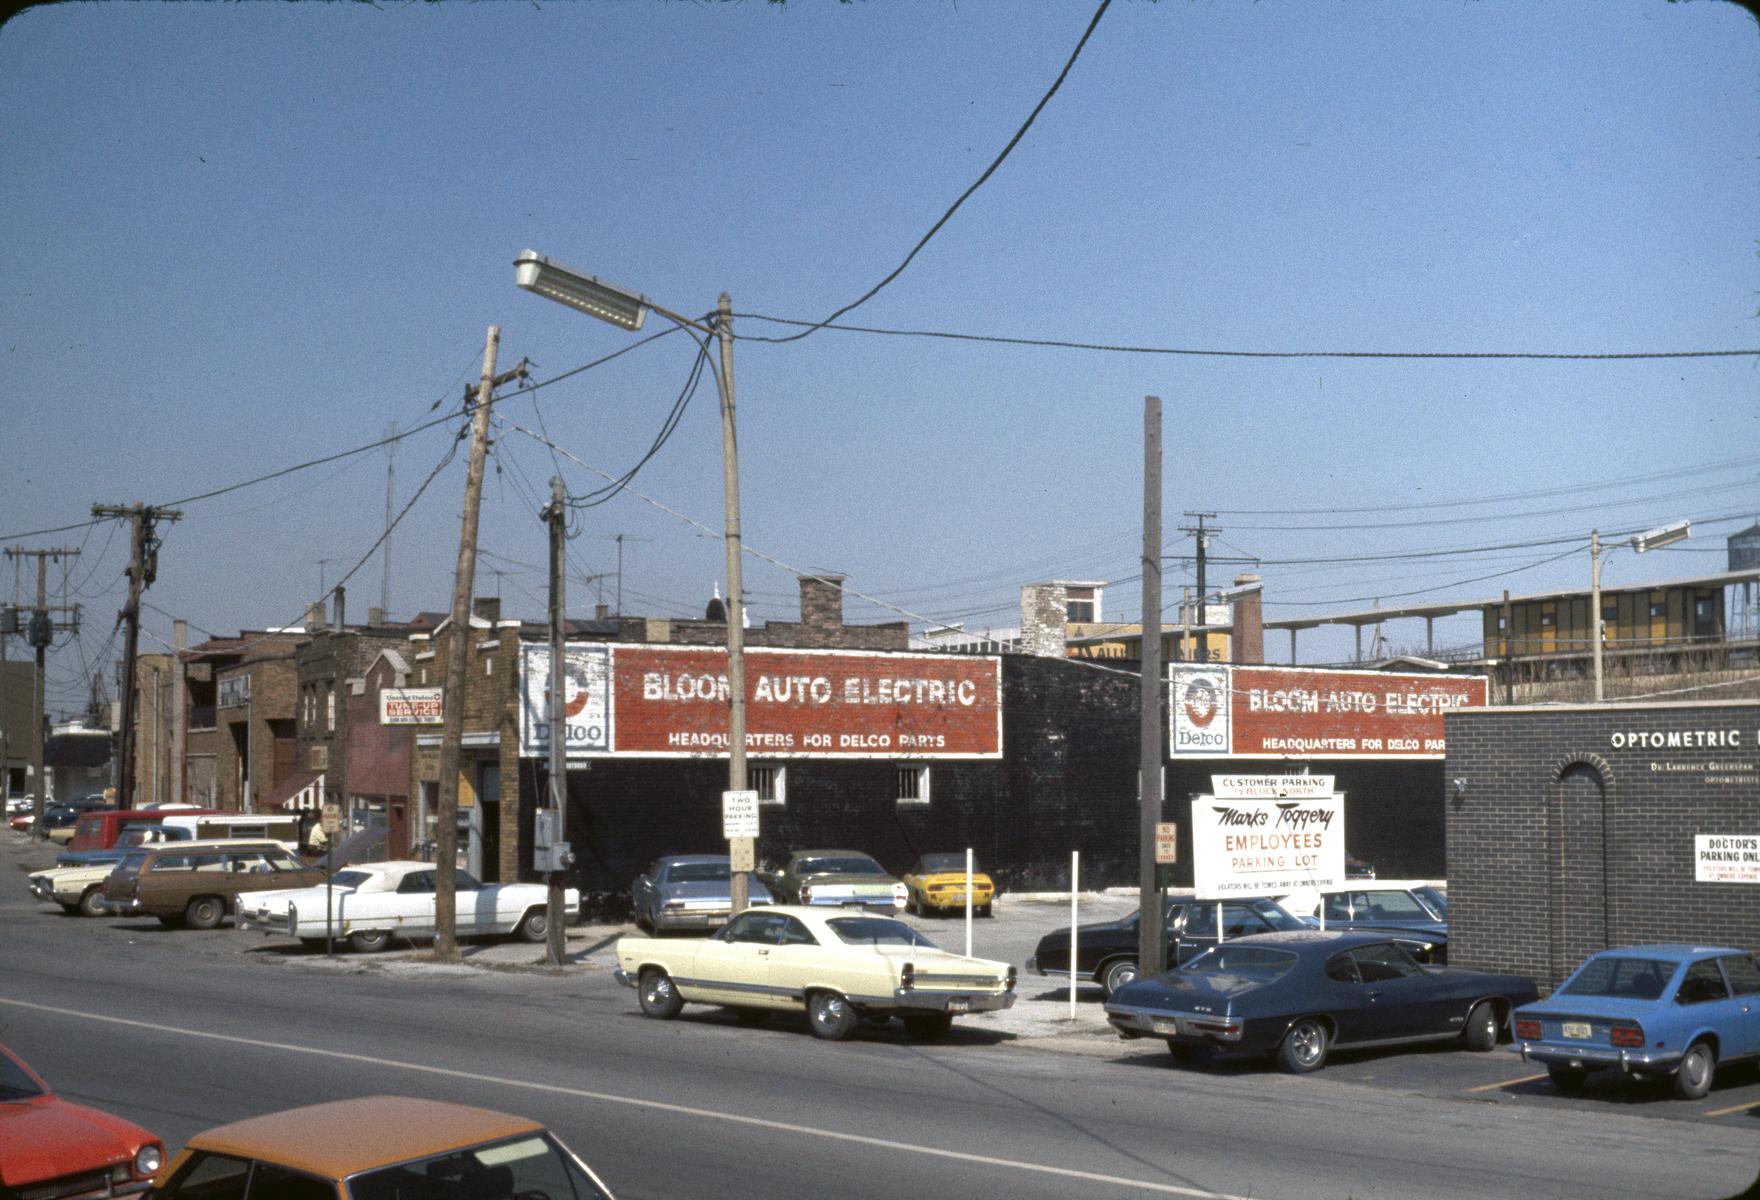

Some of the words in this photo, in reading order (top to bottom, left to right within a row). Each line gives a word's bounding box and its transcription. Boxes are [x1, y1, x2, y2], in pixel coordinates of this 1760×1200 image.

[754, 675, 832, 703] AUTO
[844, 677, 976, 706] ELECTRIC
[1249, 688, 1319, 713] BLOOM
[1326, 690, 1376, 714] AUTO
[533, 723, 601, 741] Dlco
[1178, 731, 1224, 746] Delco
[1611, 730, 1740, 748] OPTOMETRIC
[668, 732, 794, 748] HEADQURTERS
[803, 733, 832, 747] FOR
[839, 734, 891, 748] DELCO
[899, 734, 945, 747] PARTS
[1262, 737, 1356, 751] HEADQUARTERS
[1361, 738, 1383, 750] FOR
[1387, 739, 1420, 750] DELCO
[1222, 778, 1277, 787] CUSTOMER
[1282, 778, 1326, 787] PARKING
[1246, 787, 1277, 796] BLOCK
[1283, 787, 1314, 795] NORTH
[1274, 802, 1335, 831] Toggery
[1225, 833, 1322, 851] EMPLOYEES
[1708, 839, 1758, 850] DOCTOR'S
[1231, 855, 1286, 869] PARKING
[1295, 854, 1319, 867] LOT
[1700, 851, 1740, 862] PARKING
[1742, 852, 1760, 863] ONL
